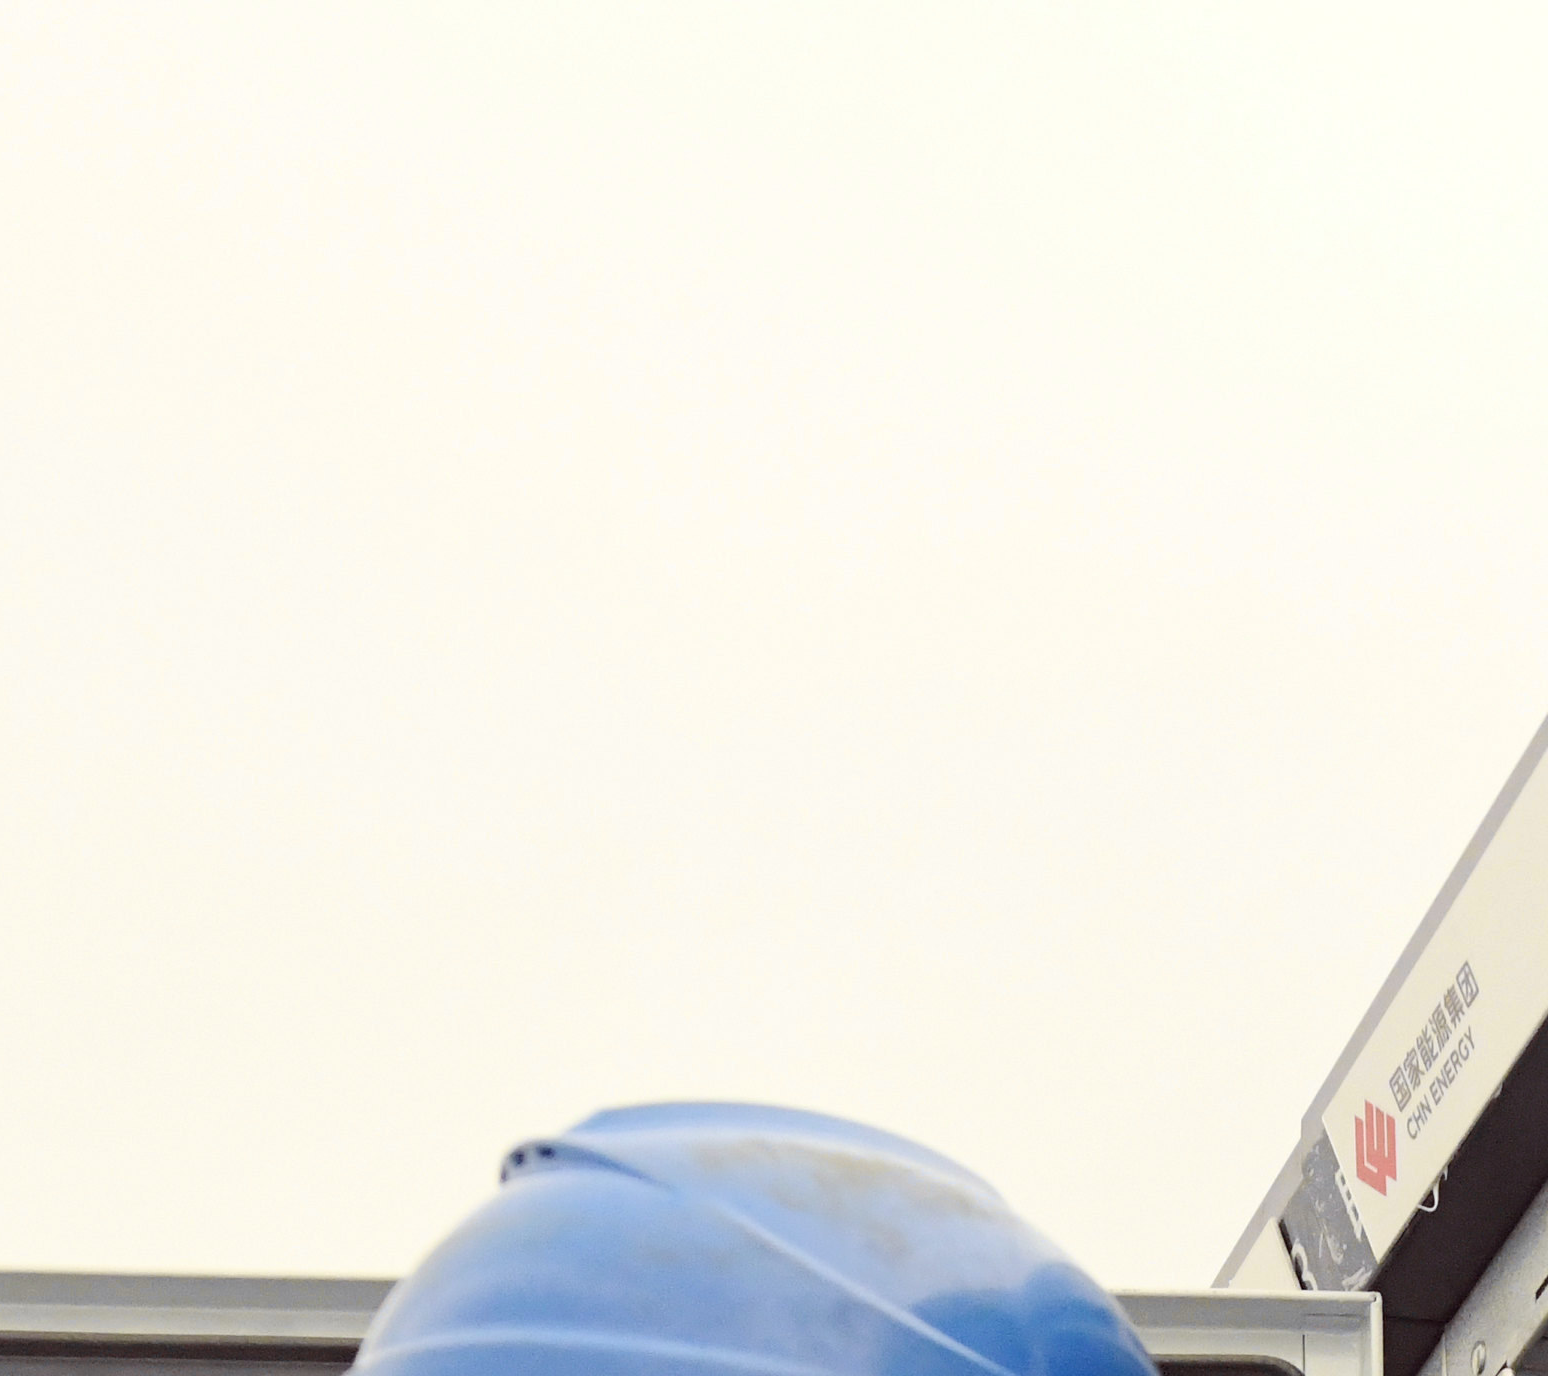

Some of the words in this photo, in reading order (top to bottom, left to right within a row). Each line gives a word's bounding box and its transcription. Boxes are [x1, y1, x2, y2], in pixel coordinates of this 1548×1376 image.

[1389, 961, 1479, 1112] 国家能源集团
[1406, 1096, 1433, 1139] CHN
[1431, 1025, 1475, 1107] ENERGY
